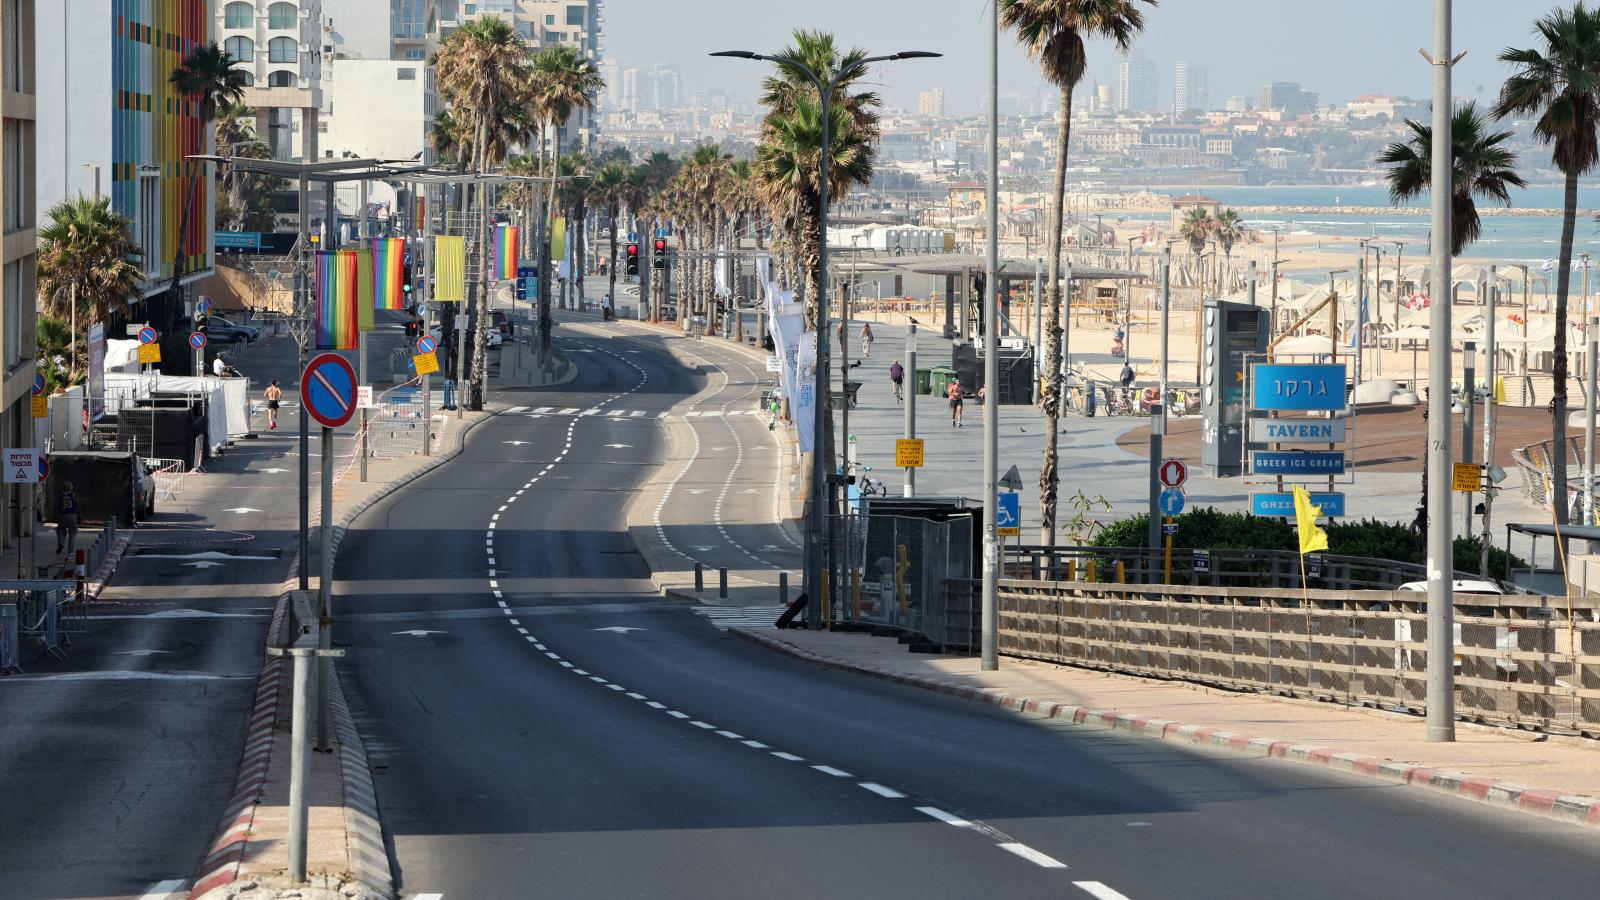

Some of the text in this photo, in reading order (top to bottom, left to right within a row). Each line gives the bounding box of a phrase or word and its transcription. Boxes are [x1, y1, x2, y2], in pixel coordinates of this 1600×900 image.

[1274, 380, 1328, 398] גרקו
[1267, 424, 1332, 438] TAVERN
[1256, 460, 1342, 468] GREEK ICE CREAM
